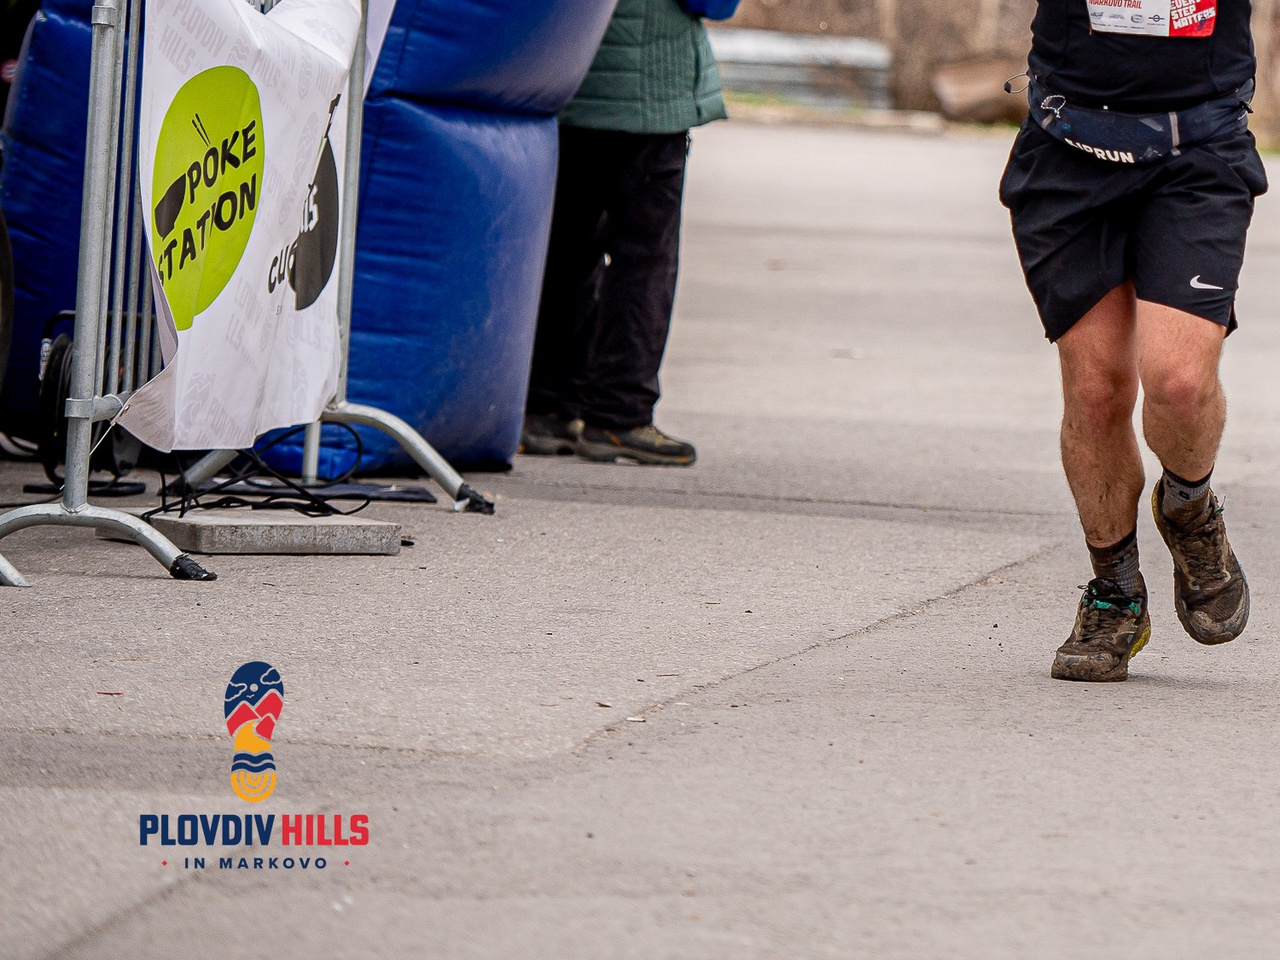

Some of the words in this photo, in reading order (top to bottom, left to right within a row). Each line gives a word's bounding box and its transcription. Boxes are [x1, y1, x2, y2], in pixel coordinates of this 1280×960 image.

[1170, 4, 1196, 20] STEP
[1172, 6, 1216, 30] MATTERS
[187, 119, 257, 205] POKE
